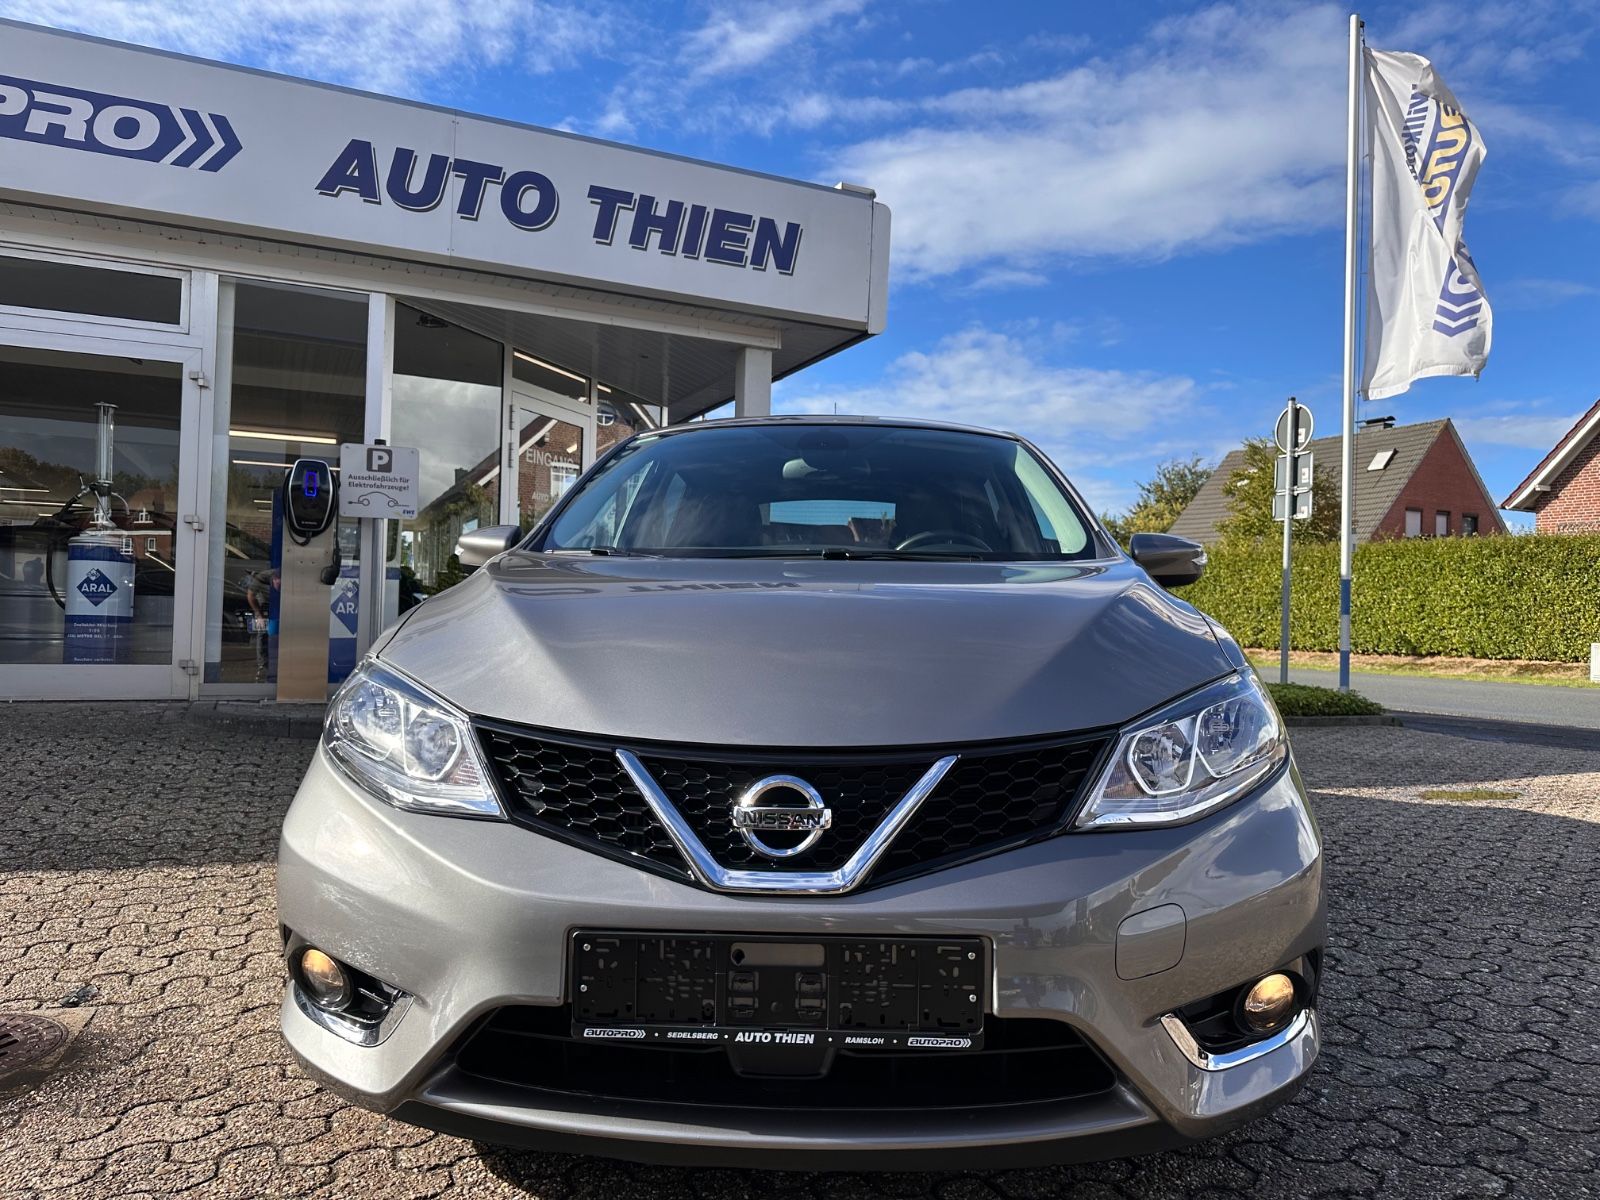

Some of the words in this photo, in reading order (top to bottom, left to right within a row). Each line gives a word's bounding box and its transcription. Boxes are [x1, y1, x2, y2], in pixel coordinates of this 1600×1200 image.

[314, 138, 559, 232] AUTO
[587, 184, 803, 275] THIEN
[348, 473, 399, 483] Ausschließlich
[348, 481, 410, 492] Elektrofahrzeuge!
[81, 582, 114, 593] ARAL
[335, 602, 359, 615] AR
[743, 811, 821, 826] NISSAN
[667, 1031, 719, 1040] SEDELSBERG
[734, 1031, 772, 1043] AUTO
[774, 1032, 815, 1045] THIEN
[844, 1036, 885, 1045] RAMSLOH
